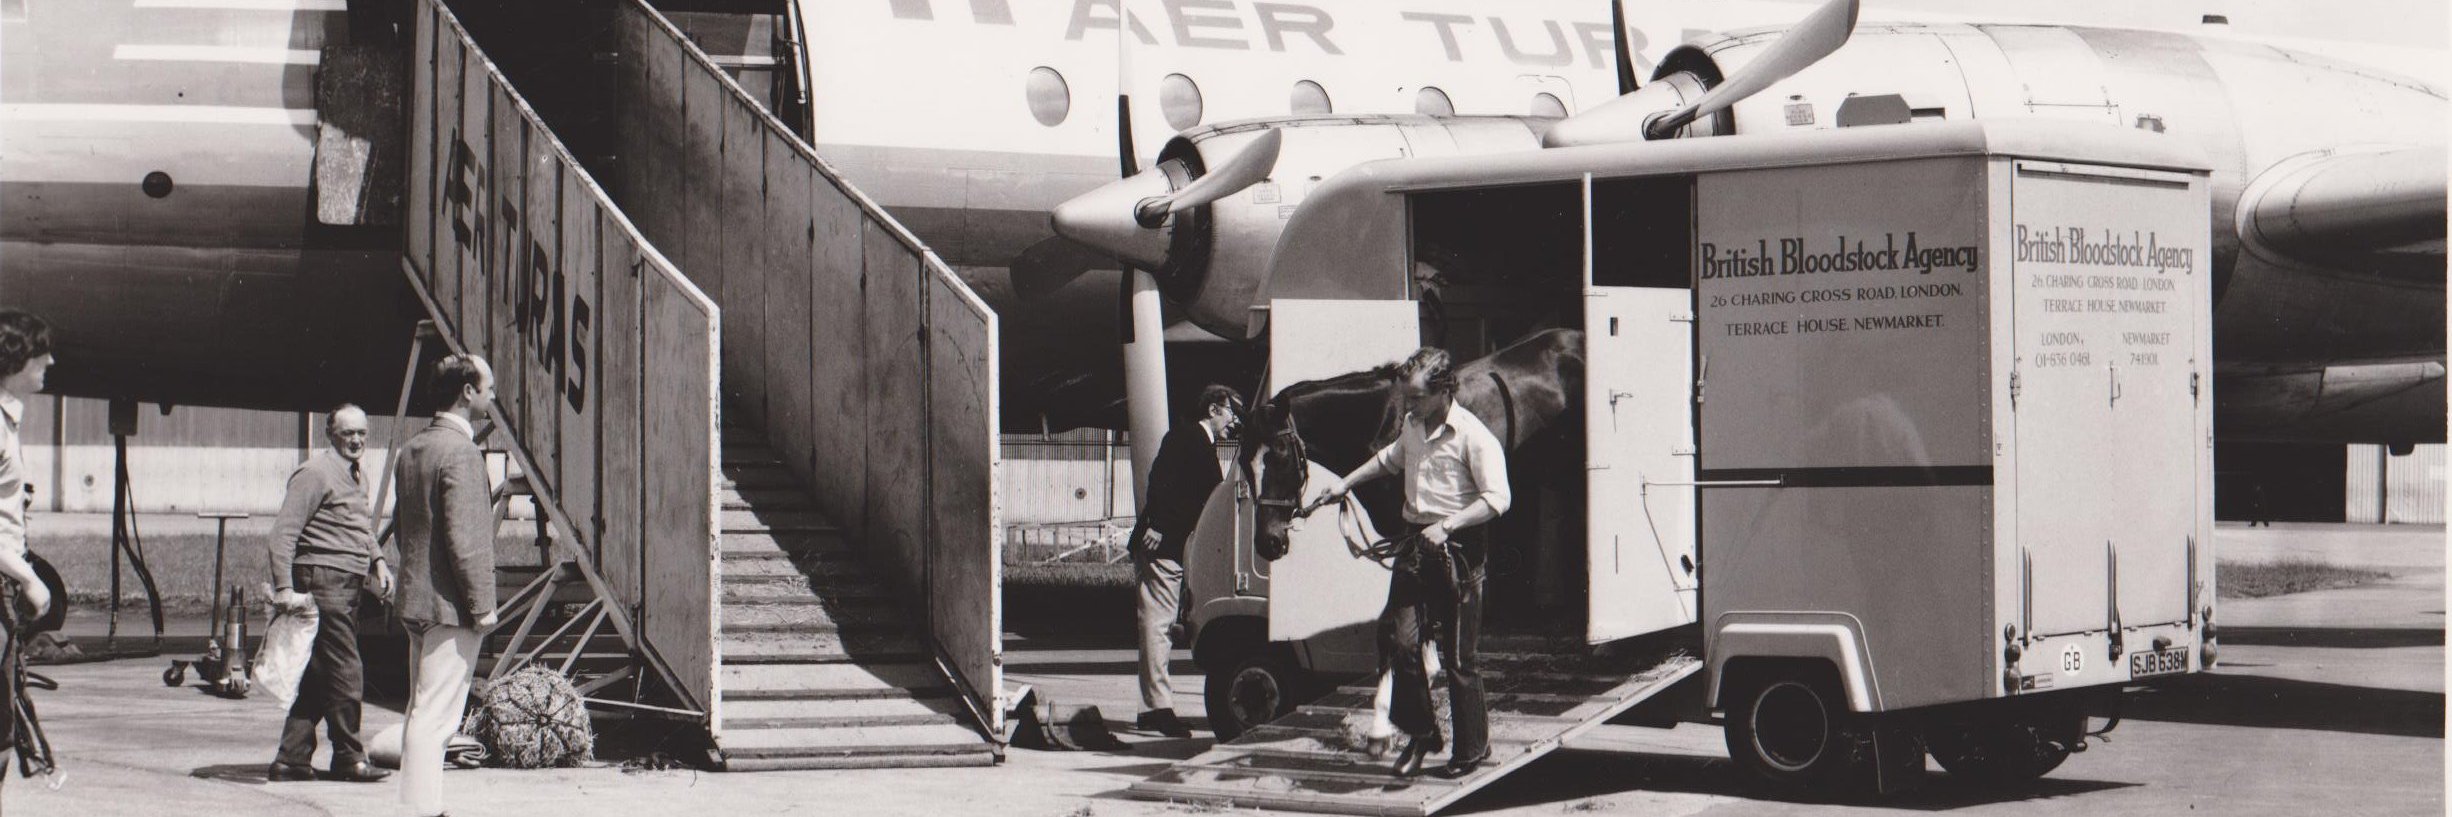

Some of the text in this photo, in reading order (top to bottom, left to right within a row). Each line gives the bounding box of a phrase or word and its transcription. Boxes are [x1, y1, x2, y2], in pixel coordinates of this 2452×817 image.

[1400, 11, 1713, 73] TUR
[1701, 231, 1978, 279] British Bloodstock Agency
[2016, 224, 2193, 275] British Bloodstock Agency
[441, 127, 590, 415] AER TURAS
[2046, 274, 2083, 289] CHARING
[2087, 275, 2115, 289] CROSS
[1710, 295, 1727, 308] 26
[1731, 290, 1796, 306] CHARING
[1801, 288, 1850, 303] CROSS
[2044, 299, 2083, 313] TERRACE
[1726, 320, 1789, 336] TERRACE
[2122, 332, 2171, 346] NEWMARKET
[2064, 651, 2081, 671] GB
[2133, 653, 2156, 674] SJB
